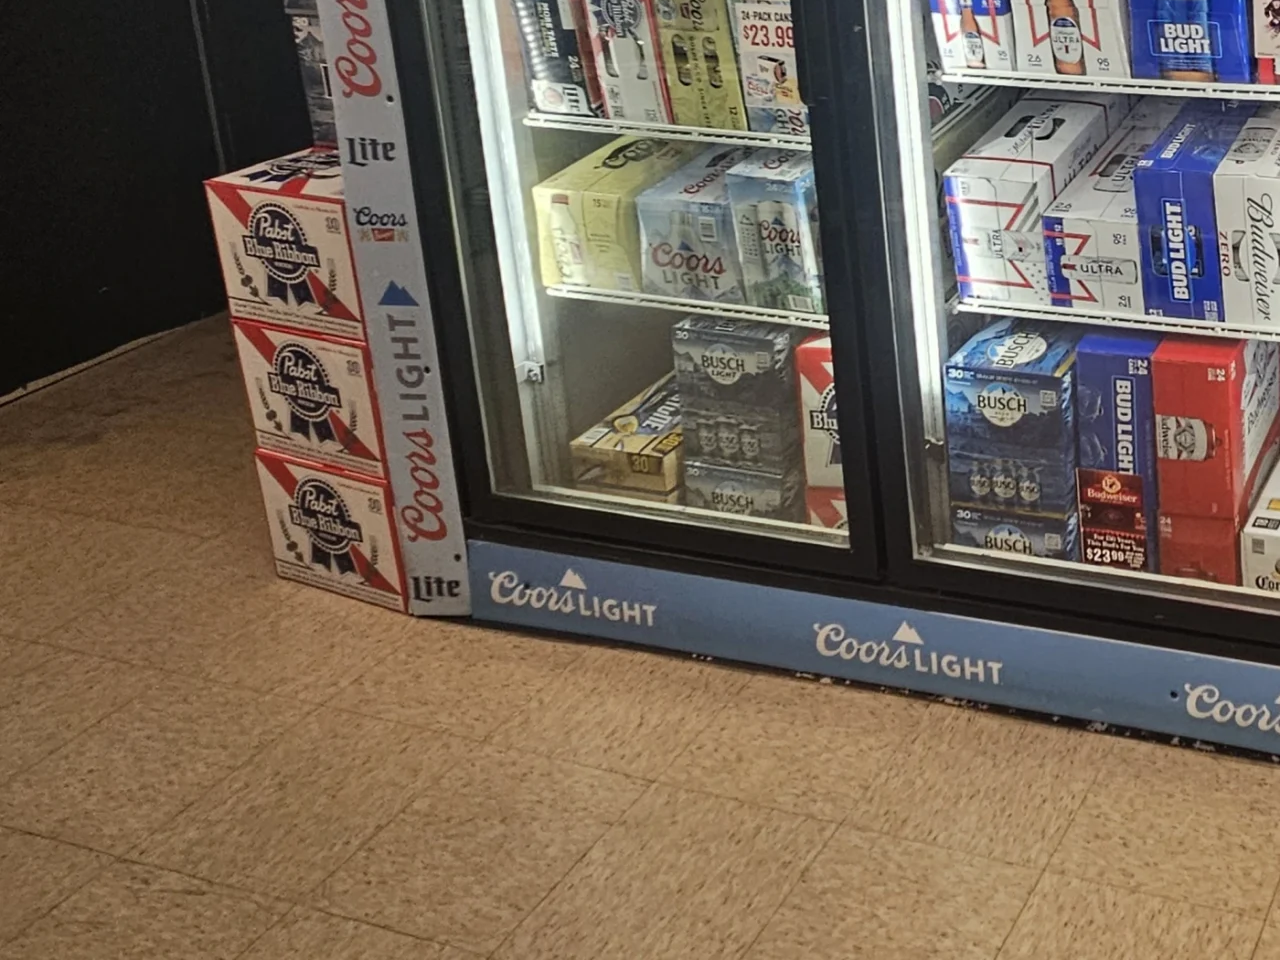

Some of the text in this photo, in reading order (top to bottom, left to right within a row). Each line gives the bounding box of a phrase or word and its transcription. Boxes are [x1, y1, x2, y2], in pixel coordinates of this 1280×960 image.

[1163, 23, 1204, 39] BUD
[1160, 38, 1211, 54] LIGHT
[345, 136, 397, 167] Lite
[255, 212, 295, 241] Pabst
[353, 206, 408, 228] Coors
[245, 237, 318, 266] Blue Ribbon
[651, 242, 727, 275] Coors
[1219, 230, 1232, 277] ZERO
[1247, 192, 1276, 321] Budweiser
[663, 270, 721, 290] LIGHT
[1080, 263, 1123, 276] ULTRA
[284, 353, 319, 381] Pabst
[701, 354, 745, 372] BUSCH
[947, 369, 964, 379] 30
[270, 377, 341, 408] Blue Ribbon
[977, 394, 1028, 413] BUSCH
[1115, 379, 1132, 423] BUD
[387, 313, 449, 543] LIGHT Coors
[305, 487, 339, 517] Pabst
[711, 491, 754, 510] BUSCH
[956, 509, 970, 520] 30
[291, 508, 363, 541] Blue Ribbon
[984, 535, 1033, 554] BUSCH
[411, 575, 462, 604] Lite
[488, 570, 657, 627] Coors LIGHT
[813, 621, 1003, 685] Coors LIGHT
